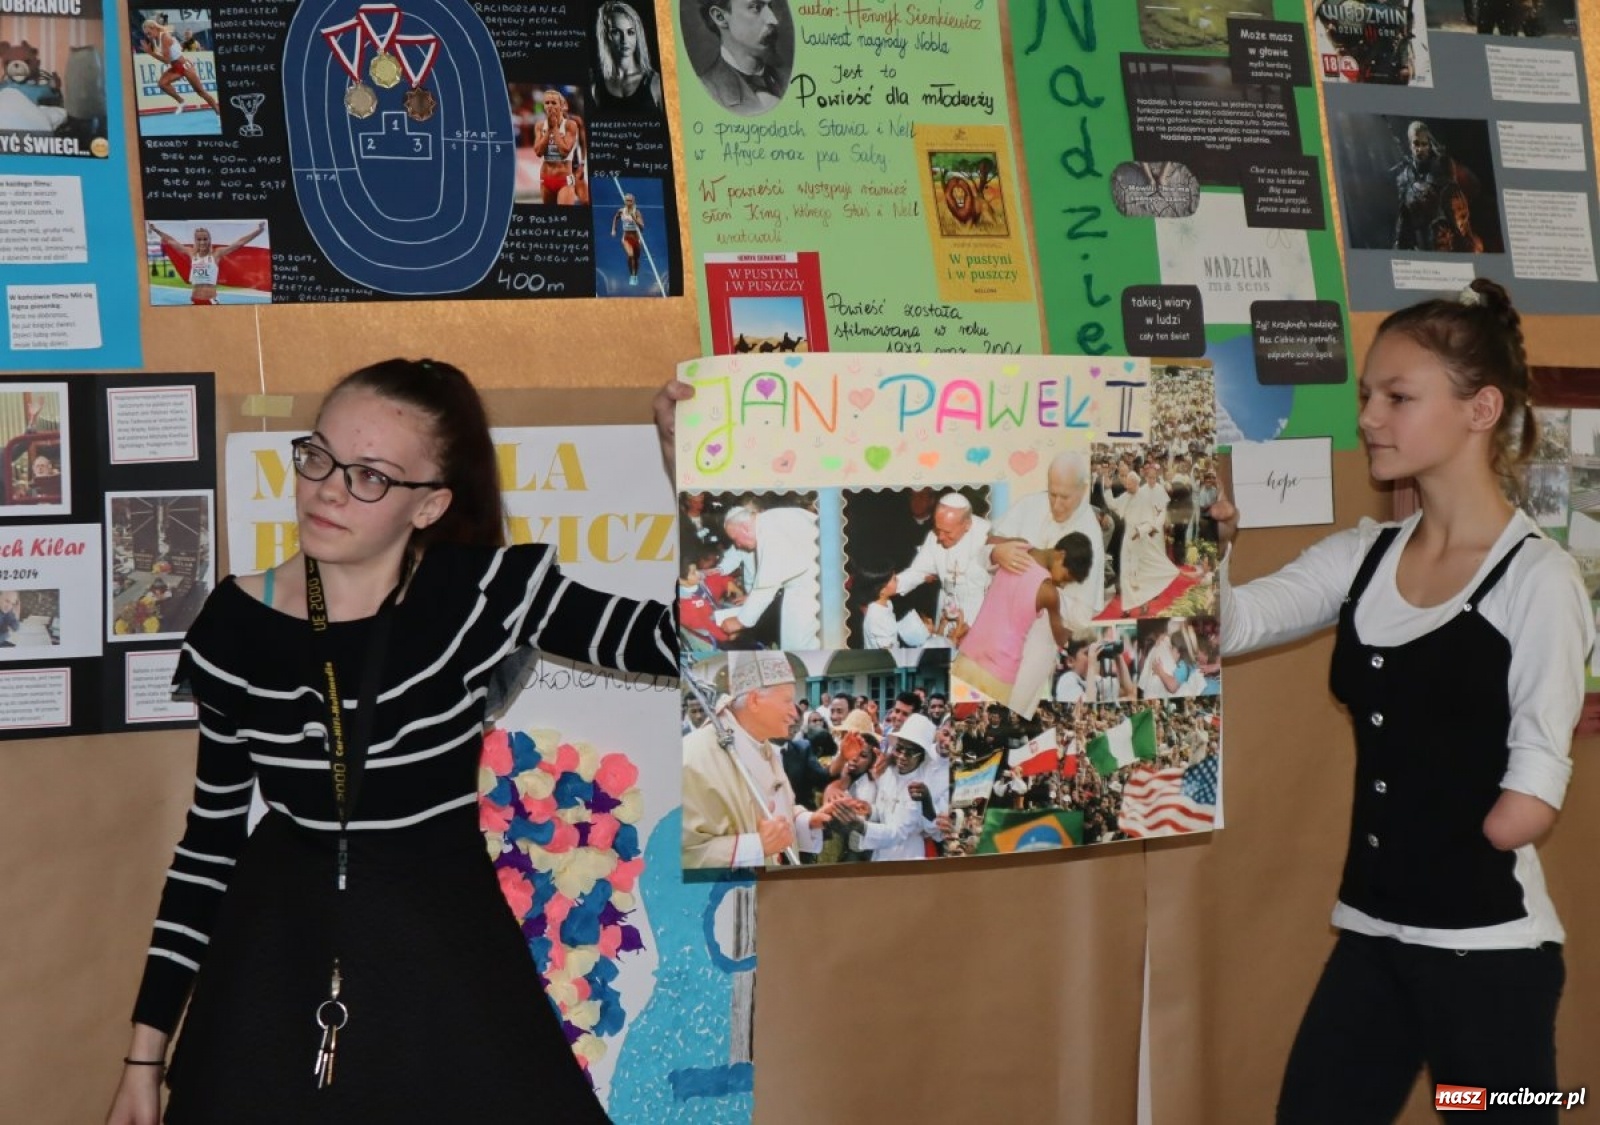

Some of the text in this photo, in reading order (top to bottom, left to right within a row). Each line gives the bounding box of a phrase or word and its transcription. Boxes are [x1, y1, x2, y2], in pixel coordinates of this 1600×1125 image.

[906, 3, 982, 31] Sienkiewicz
[1240, 29, 1293, 42] Może masz
[857, 29, 908, 59] nagrody
[1259, 46, 1289, 58] głowie
[832, 64, 897, 84] Jest to
[790, 73, 874, 109] Powieść
[885, 85, 909, 106] dla
[391, 119, 401, 131] 1
[455, 130, 498, 139] START
[714, 121, 805, 146] przygodach
[367, 138, 423, 152] 2 3
[771, 149, 805, 160] oraz
[949, 253, 1013, 268] W pustyni
[1203, 256, 1272, 279] NADZIEJA
[727, 268, 798, 280] W PUSTYNI
[955, 271, 966, 279] w
[970, 270, 1018, 282] puszczy
[732, 281, 745, 292] W
[747, 280, 805, 292] PUSZCZY
[1208, 282, 1270, 292] ma sens
[826, 292, 963, 320] Powieść została
[1131, 295, 1192, 310] takiej wiary
[1145, 313, 1181, 325] w ludzi
[834, 321, 989, 341] sfilmowana w roku
[692, 371, 839, 475] JAN
[0, 537, 86, 558] ch Kilar
